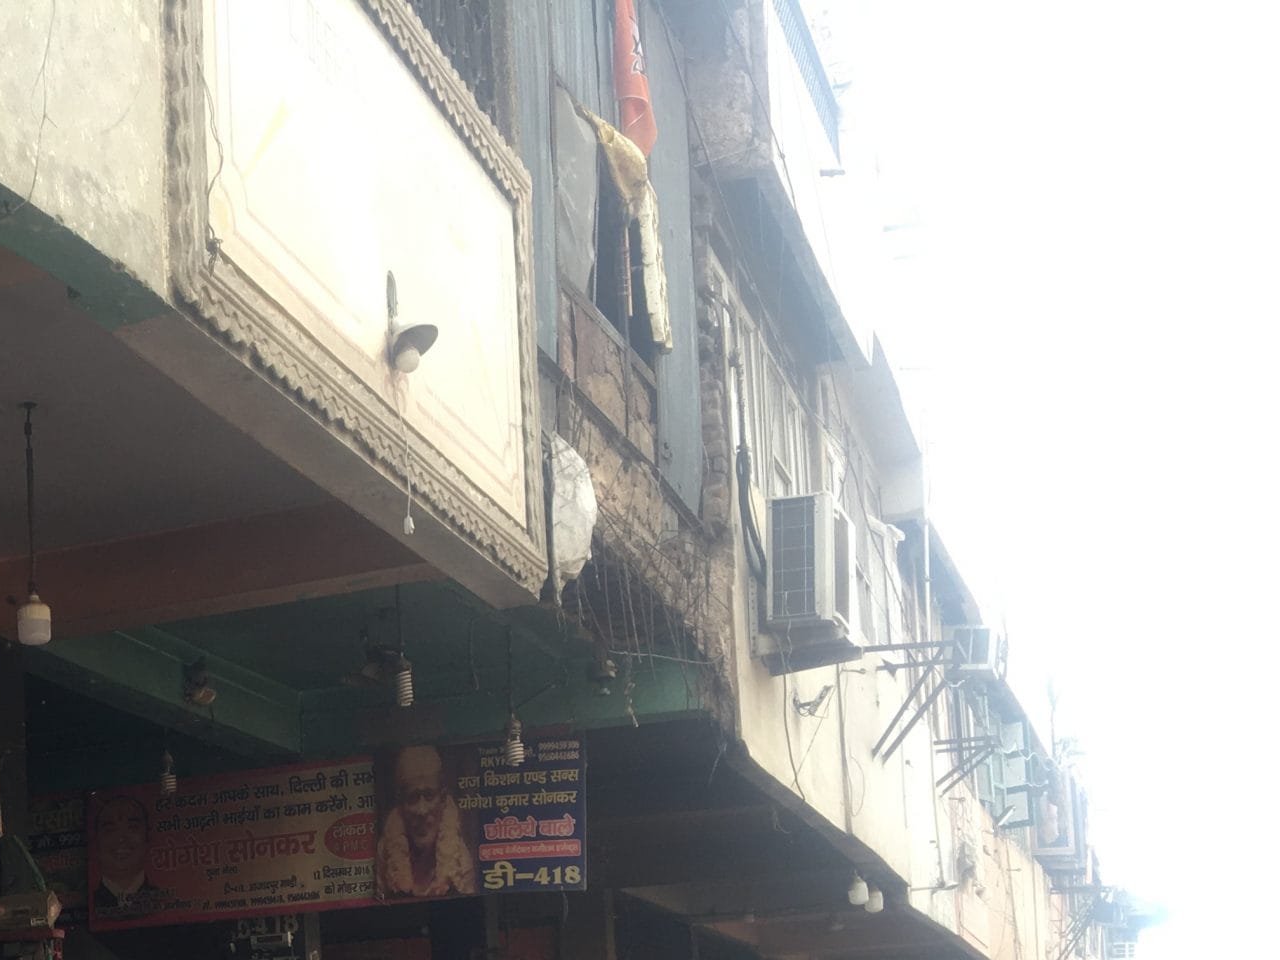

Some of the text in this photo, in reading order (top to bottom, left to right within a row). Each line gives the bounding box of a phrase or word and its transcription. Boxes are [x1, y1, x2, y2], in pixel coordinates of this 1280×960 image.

[175, 793, 208, 809] कदम
[213, 784, 250, 804] आपके
[288, 771, 326, 794] दिल्ली
[330, 769, 349, 788] की
[458, 768, 579, 789] राज किशन एण्ड सन्स
[458, 788, 578, 814] योगेश कुमार सोनकर
[157, 814, 180, 832] सभी
[263, 807, 280, 821] का
[284, 803, 311, 816] काम
[539, 813, 576, 836] वाले
[150, 829, 317, 872] योगेश सोनकर
[482, 860, 581, 889] डी-418
